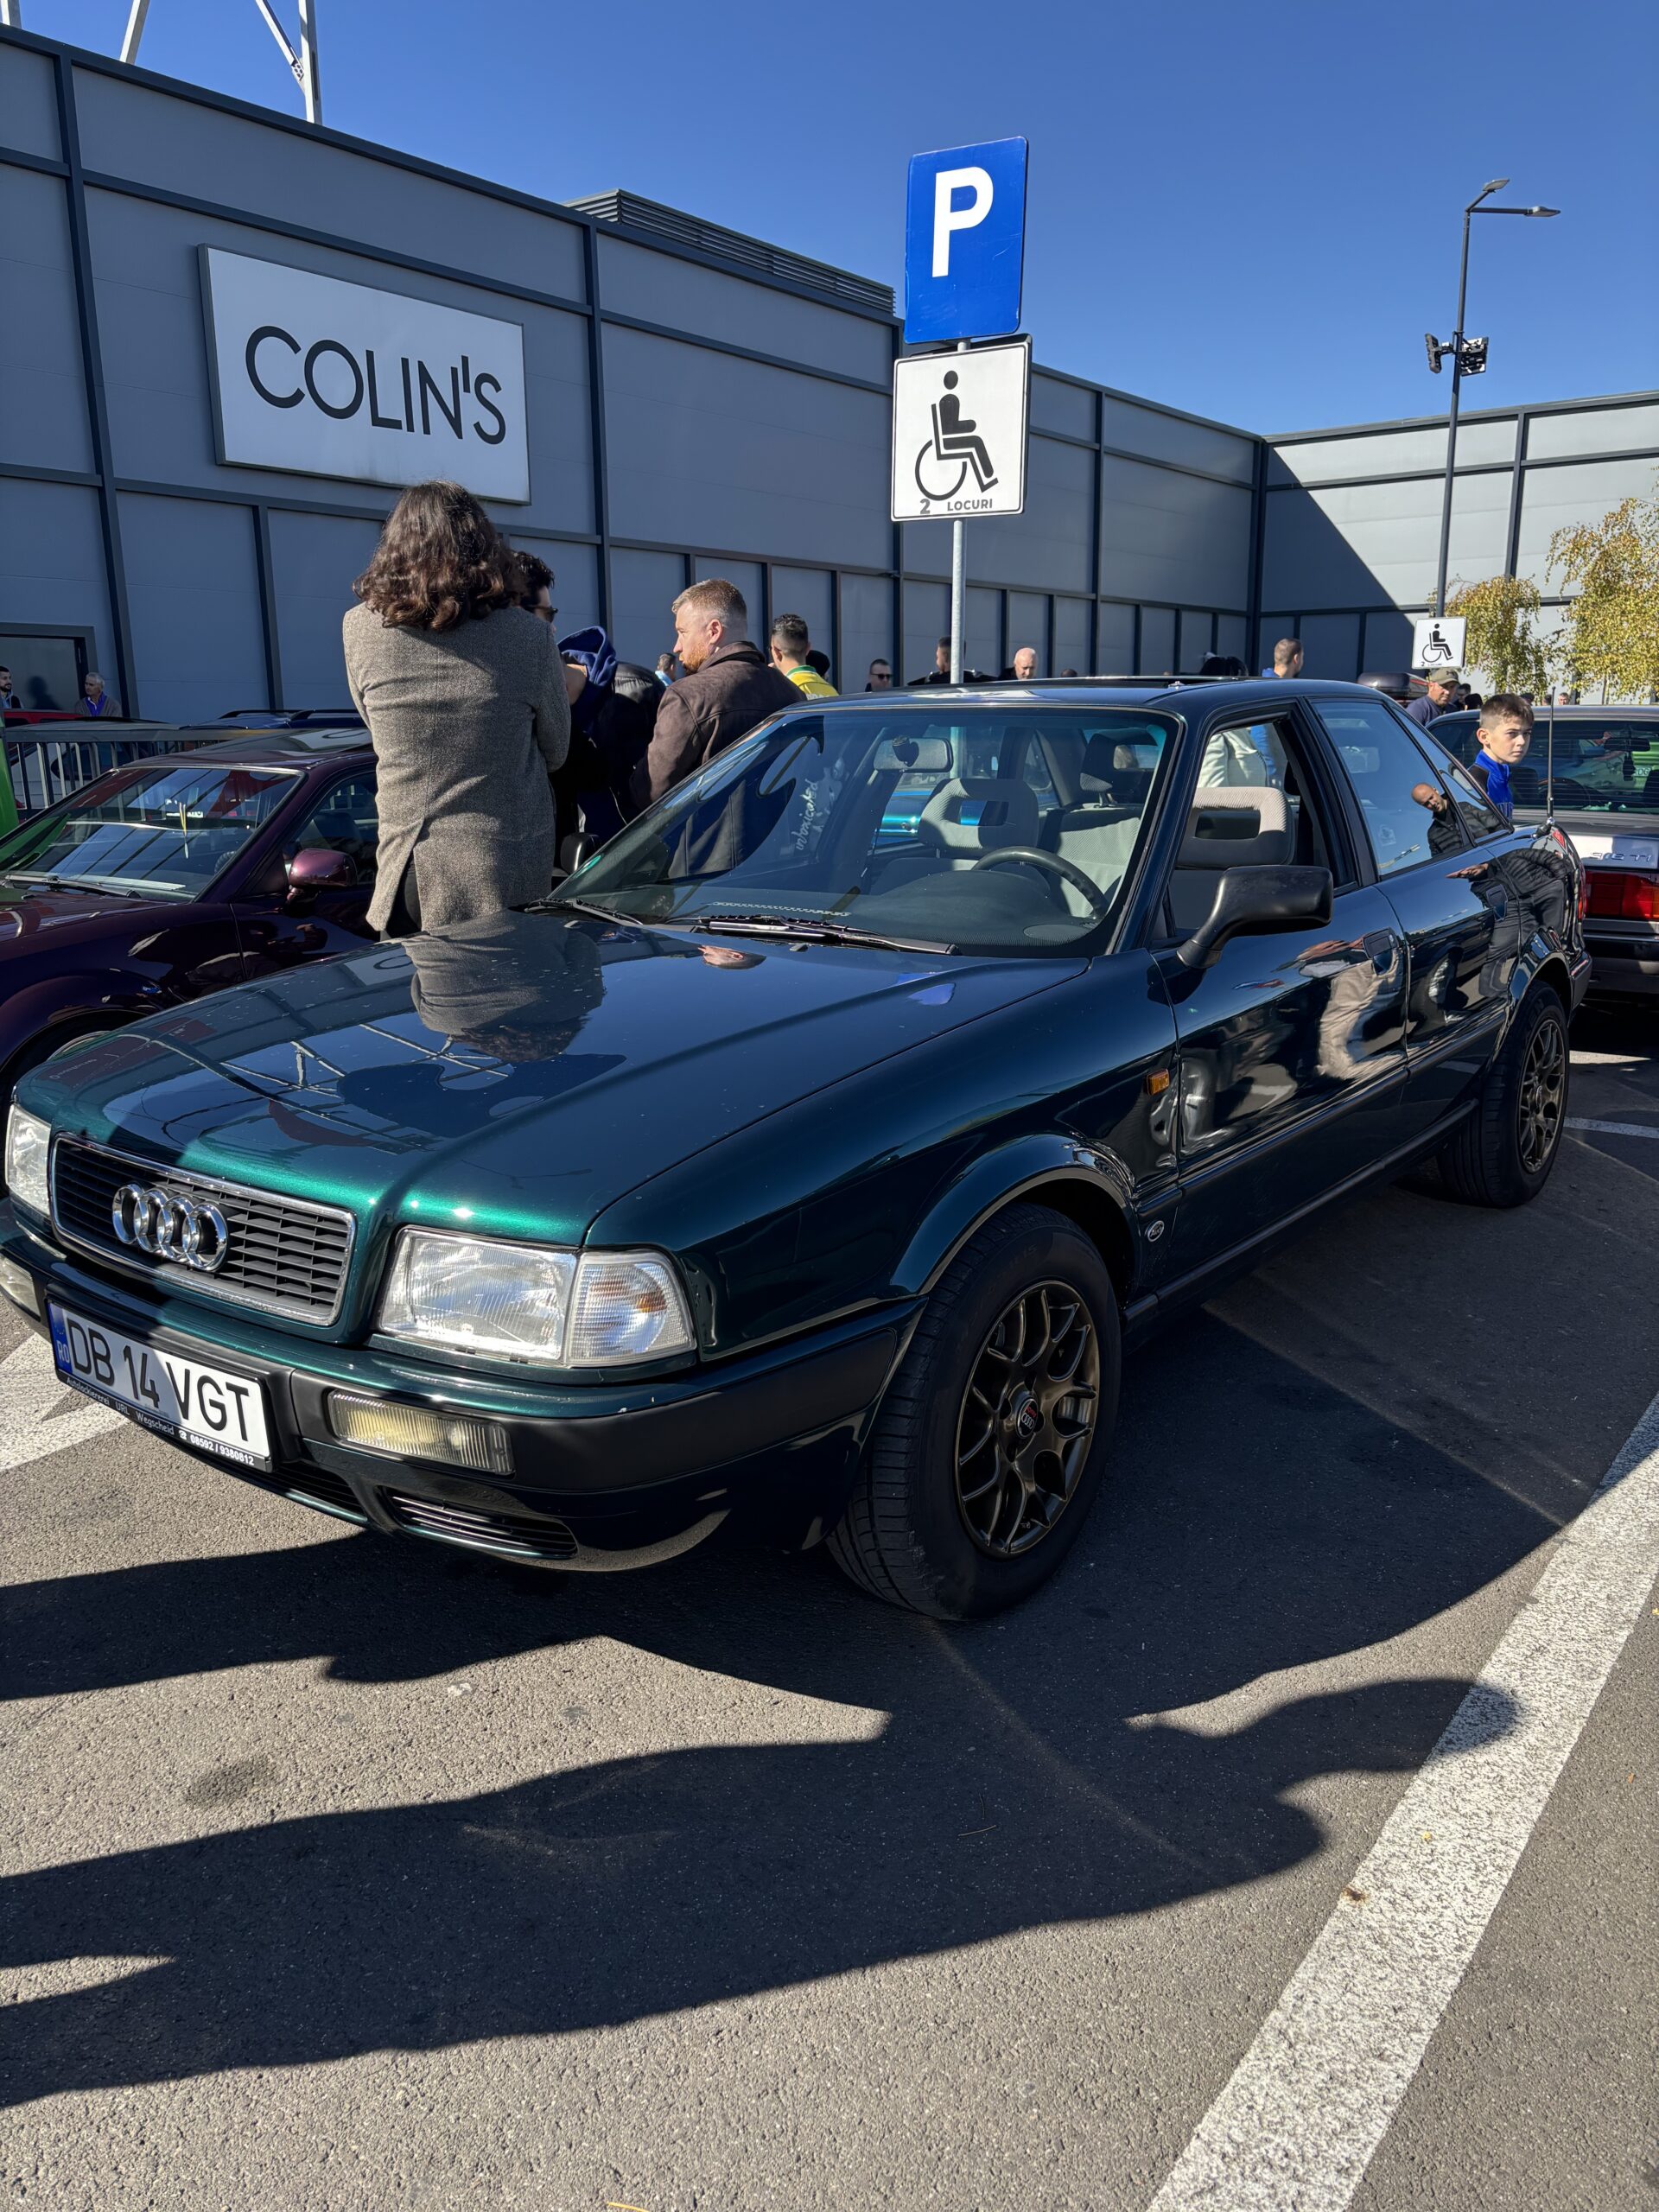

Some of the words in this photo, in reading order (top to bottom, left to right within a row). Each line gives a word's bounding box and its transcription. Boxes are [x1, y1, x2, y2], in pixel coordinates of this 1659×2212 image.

[932, 166, 994, 278] P
[245, 325, 506, 445] COLIN'S
[919, 499, 931, 515] 2
[947, 499, 993, 512] LOCURI
[56, 1339, 70, 1363] RO
[67, 1318, 115, 1387] DB
[123, 1344, 160, 1408] 14
[165, 1362, 249, 1442] VGT
[136, 1411, 175, 1434] Wegscheid
[190, 1434, 214, 1452] 08592
